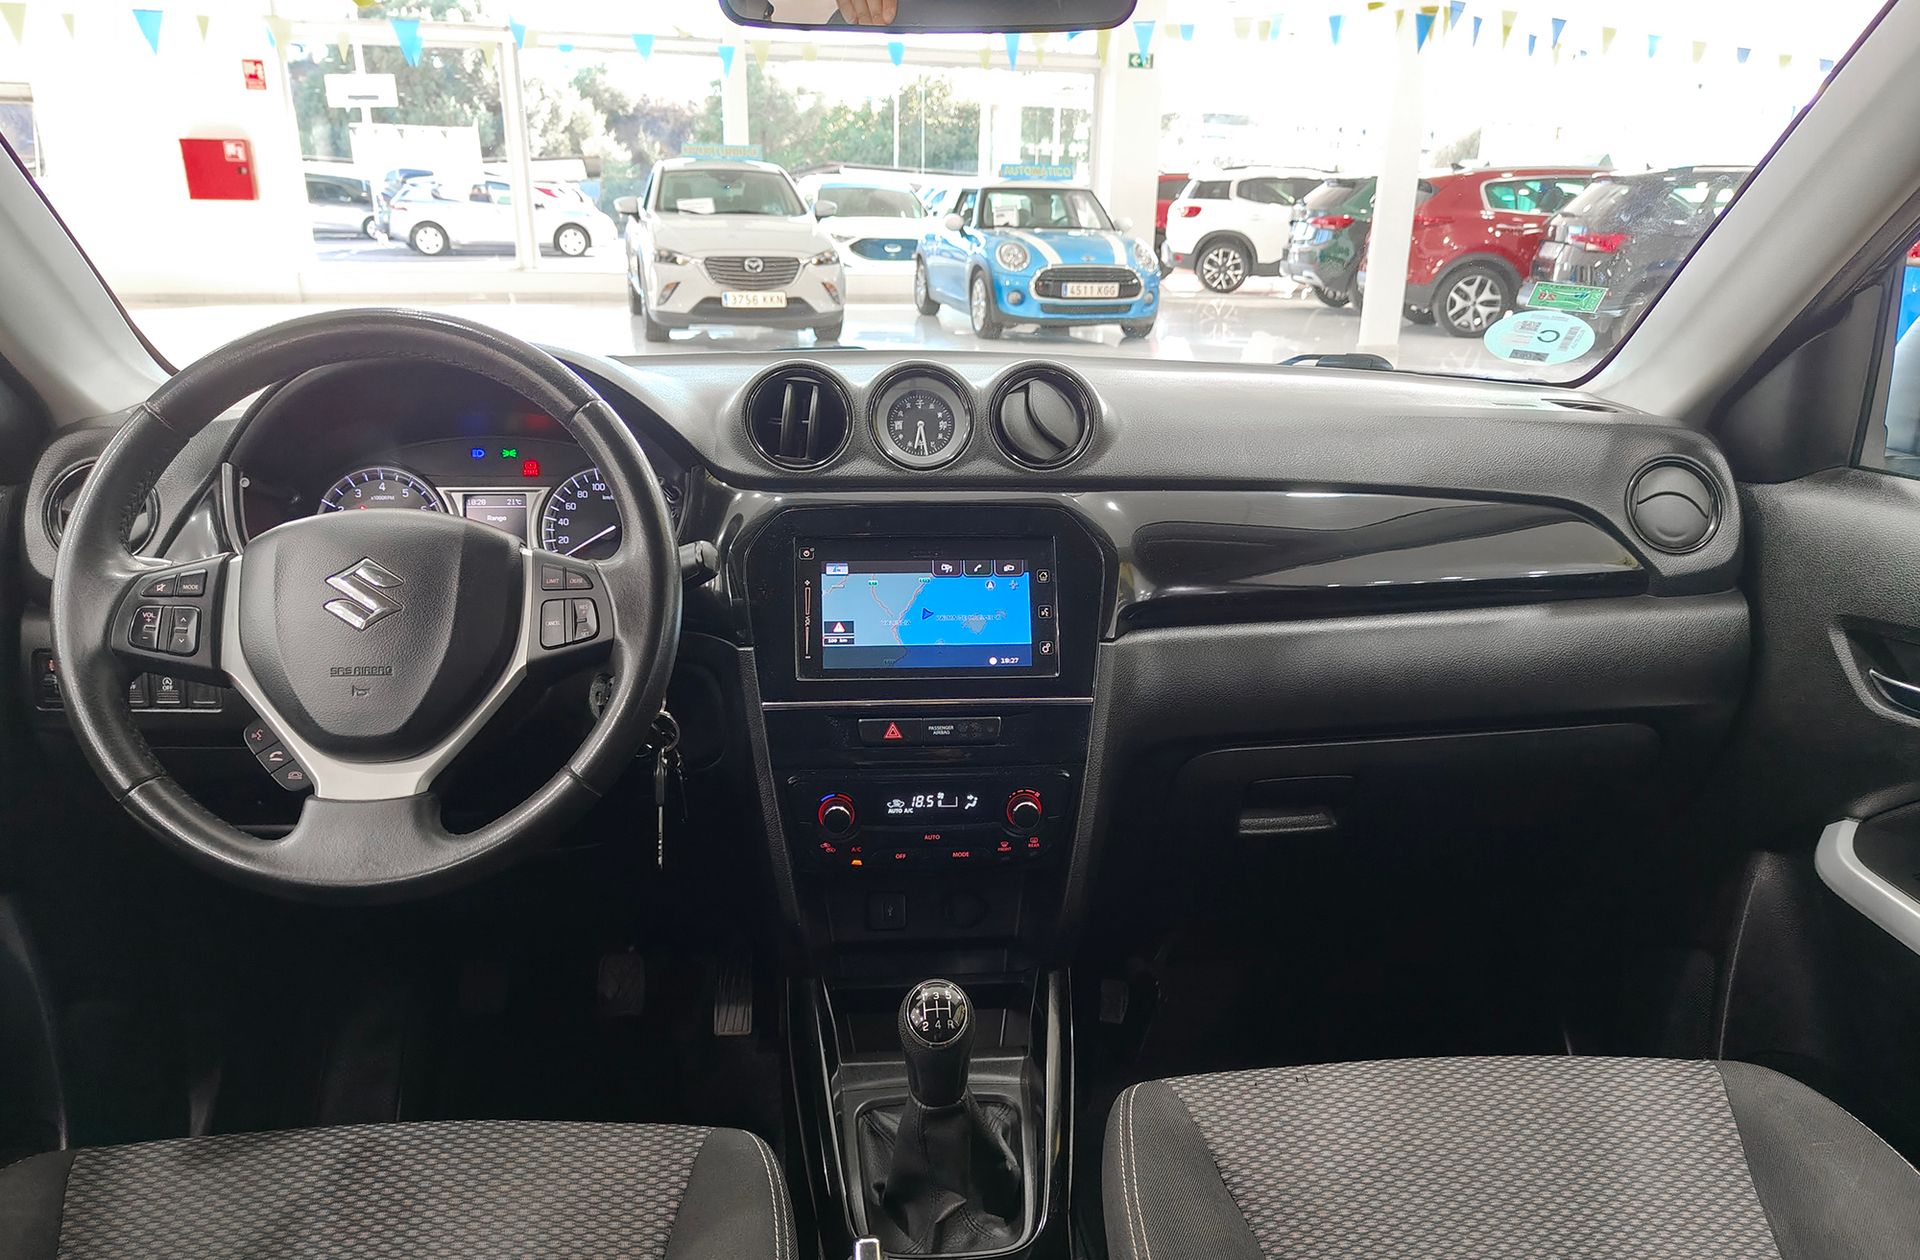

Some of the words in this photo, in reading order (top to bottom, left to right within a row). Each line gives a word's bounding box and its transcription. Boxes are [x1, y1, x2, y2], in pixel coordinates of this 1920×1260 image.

[1070, 285, 1093, 295] 4511
[732, 295, 758, 305] 3756
[378, 482, 386, 491] 4
[592, 483, 606, 491] 100
[354, 488, 362, 498] 3
[402, 488, 409, 498] 5
[577, 490, 588, 499] 80
[565, 502, 576, 511] 60
[558, 518, 569, 526] 40
[558, 536, 569, 545] 20
[330, 666, 352, 675] SRS
[354, 665, 393, 676] AIRBAG
[911, 795, 934, 808] 18.5
[932, 991, 940, 1000] 3
[944, 991, 952, 1000] 5
[922, 1021, 929, 1032] 2
[934, 1019, 942, 1030] 4
[947, 1020, 955, 1029] R
